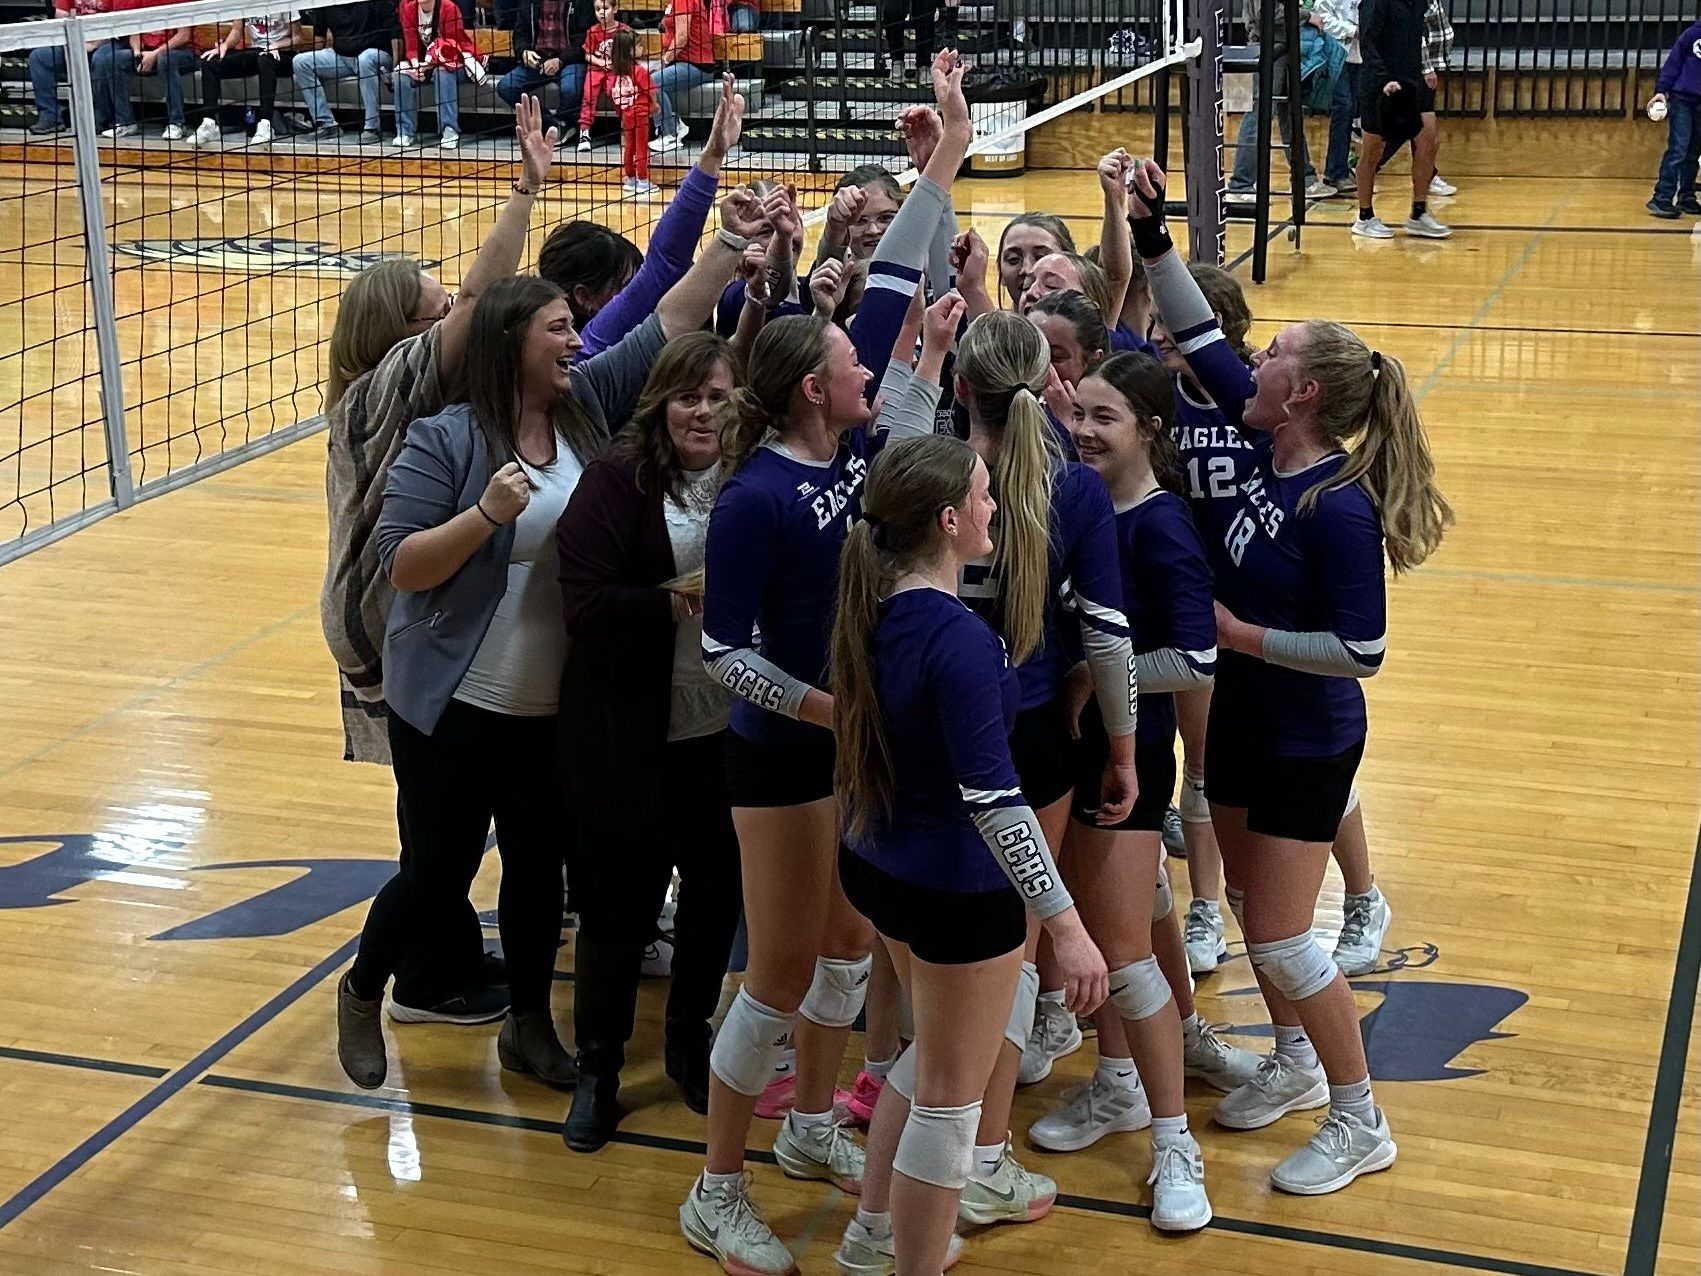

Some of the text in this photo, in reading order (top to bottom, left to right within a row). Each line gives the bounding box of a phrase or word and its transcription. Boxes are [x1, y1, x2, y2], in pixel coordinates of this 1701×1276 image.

[1187, 456, 1237, 499] 12
[1224, 508, 1256, 568] 18
[721, 659, 786, 711] GCHS
[993, 820, 1054, 899] GCHS
